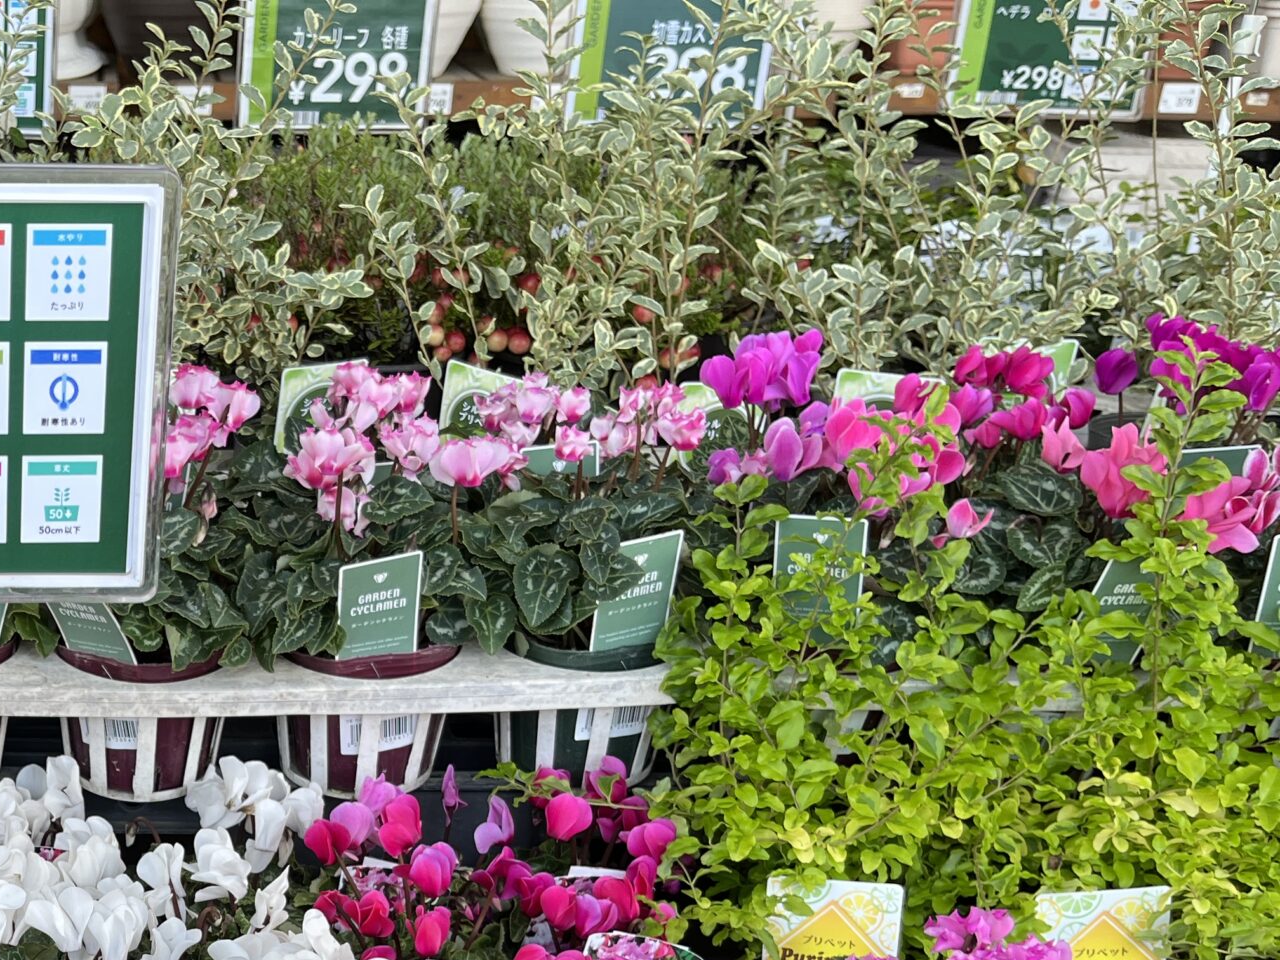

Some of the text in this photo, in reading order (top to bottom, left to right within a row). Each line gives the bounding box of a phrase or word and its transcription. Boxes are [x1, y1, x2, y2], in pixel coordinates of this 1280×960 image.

[996, 4, 1031, 19] ヘデラ
[381, 25, 409, 50] 各種
[1001, 65, 1063, 91] ¥298
[57, 233, 84, 243] 水やり
[50, 301, 85, 312] たっぷり
[48, 508, 63, 520] 50
[38, 525, 82, 536] 50cm以下
[358, 588, 400, 605] GARDEN
[350, 597, 407, 617] CYCLAMEN
